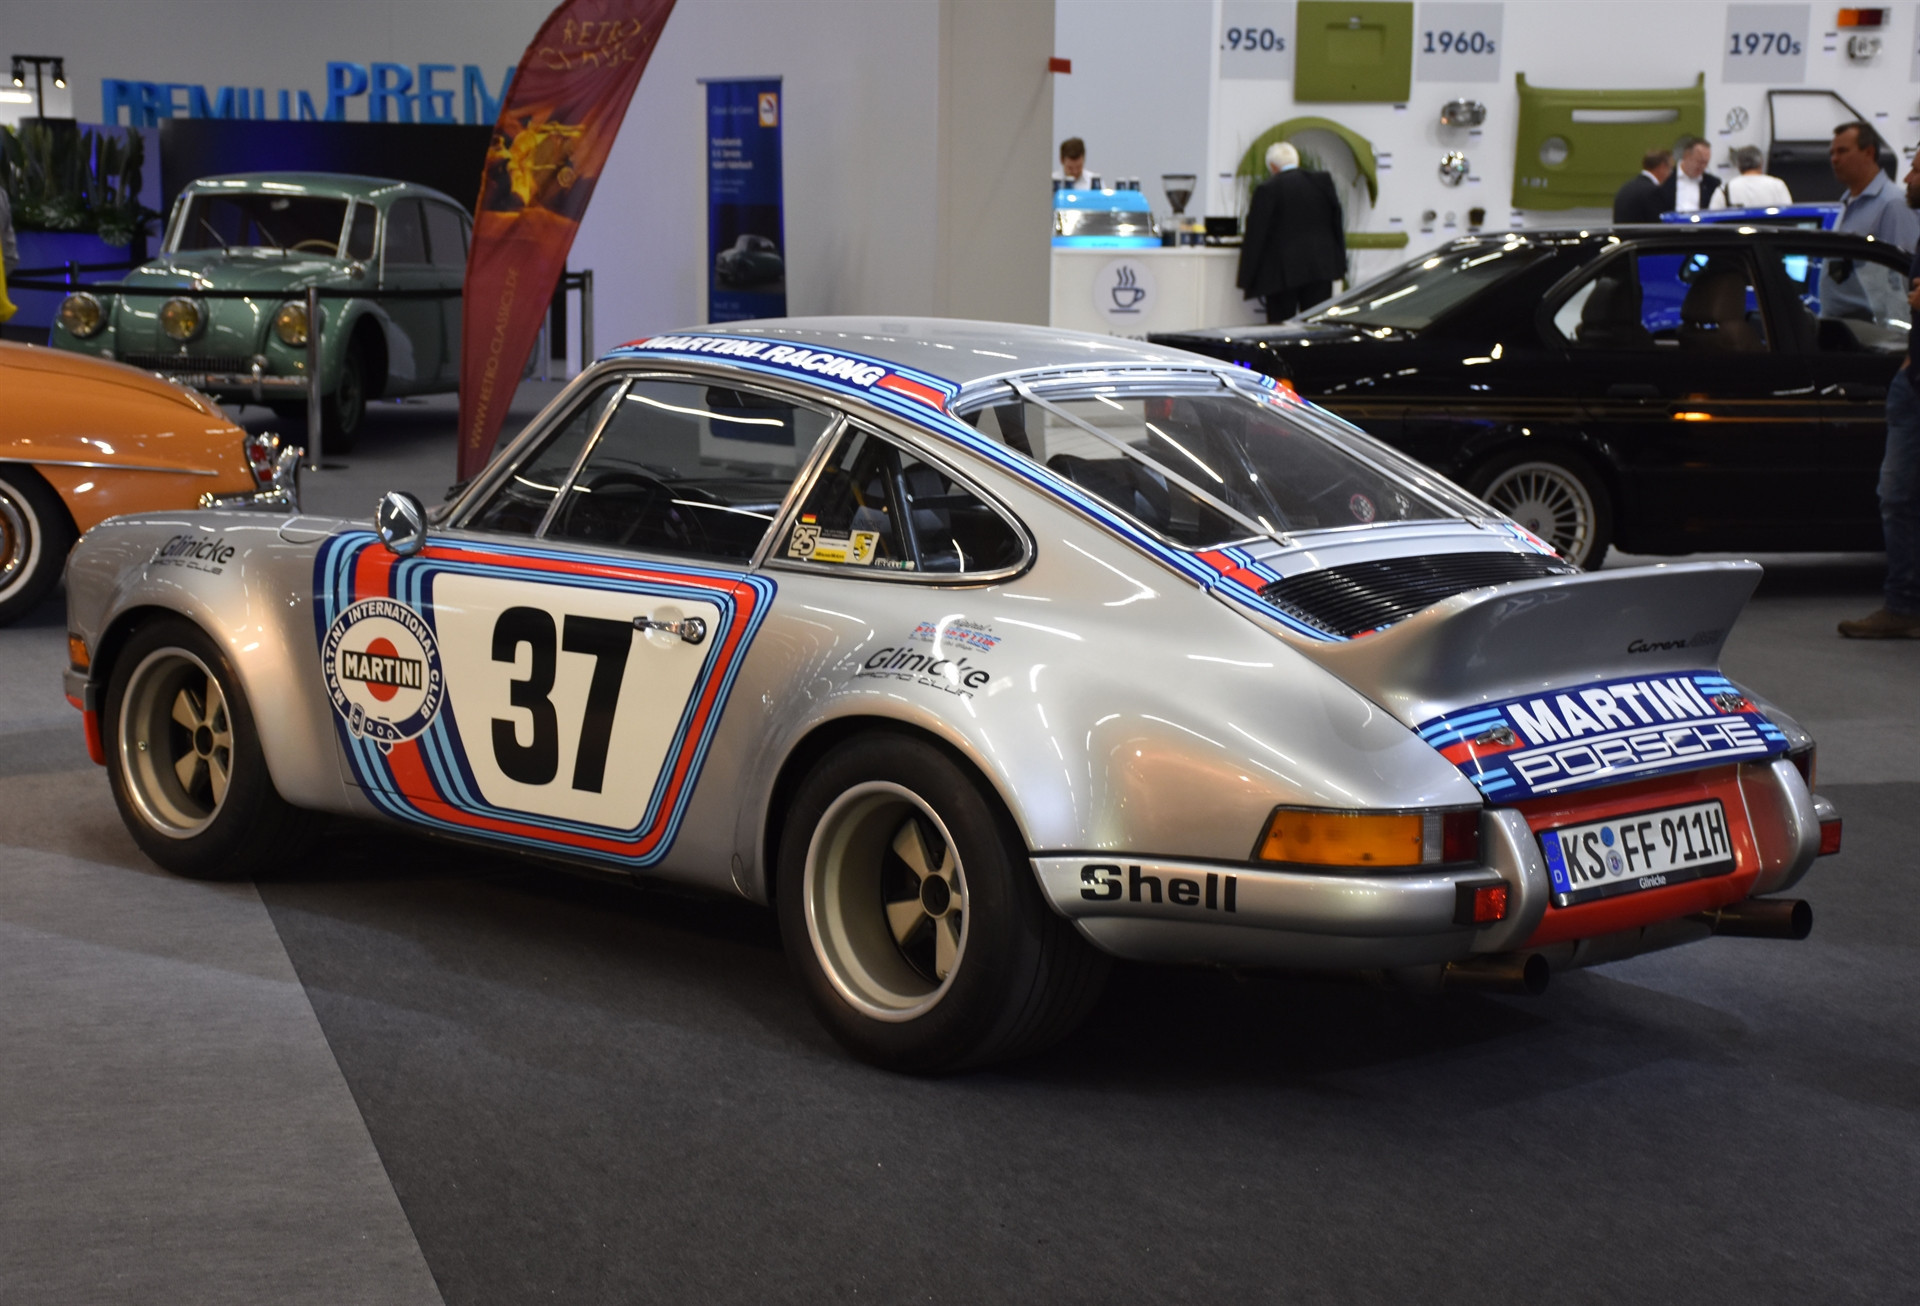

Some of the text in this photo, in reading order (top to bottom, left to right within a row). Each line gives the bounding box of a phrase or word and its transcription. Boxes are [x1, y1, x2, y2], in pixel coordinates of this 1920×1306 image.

[1220, 27, 1285, 52] 950s
[1423, 30, 1496, 55] 1960s
[1729, 32, 1802, 56] 1970s
[758, 345, 886, 387] RACING
[160, 534, 236, 565] Glinicke
[325, 601, 440, 720] MARTINI INTERNATIONAL CLUB
[344, 652, 421, 688] MARTINI
[864, 646, 990, 689] Glinicke
[491, 606, 634, 794] 37
[1506, 677, 1716, 745] MARTINI
[1512, 721, 1765, 785] PORSCHE
[1561, 831, 1606, 884] KS
[1620, 821, 1656, 873] FF
[1660, 808, 1728, 864] 911H
[1080, 864, 1237, 913] Shell
